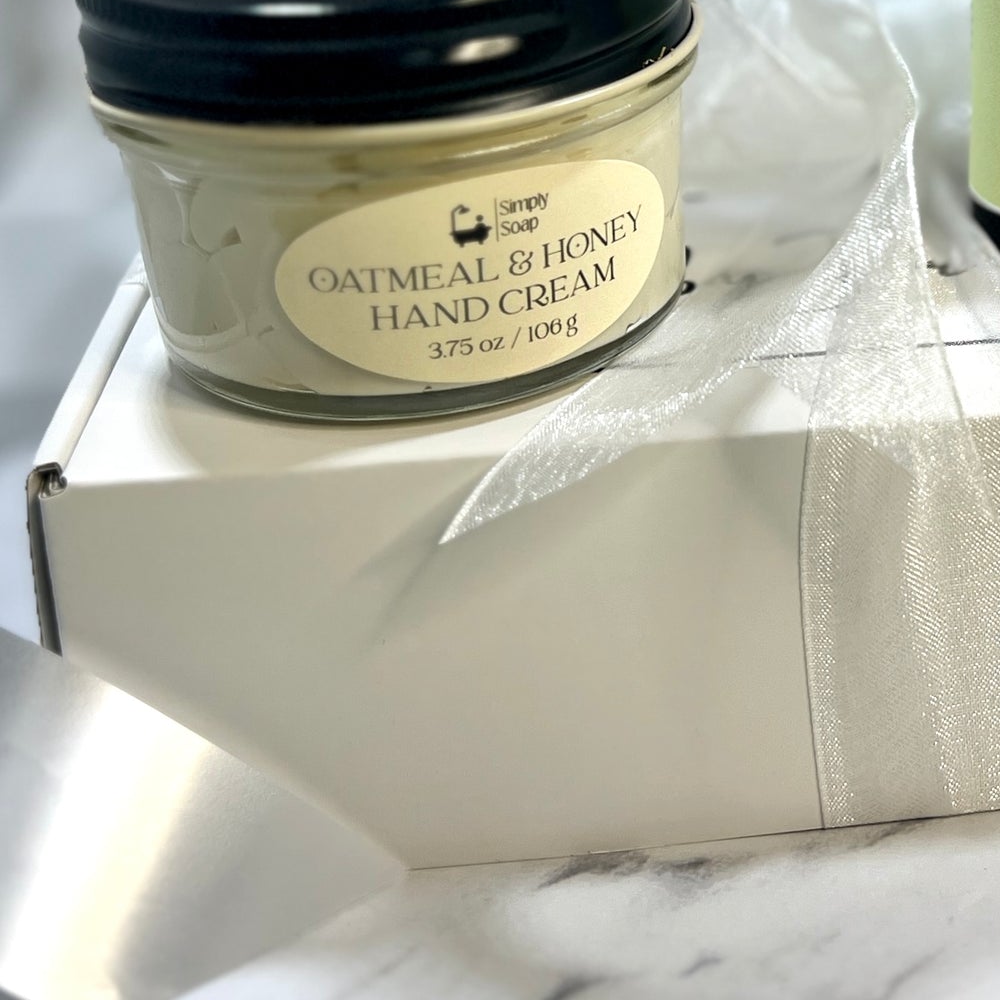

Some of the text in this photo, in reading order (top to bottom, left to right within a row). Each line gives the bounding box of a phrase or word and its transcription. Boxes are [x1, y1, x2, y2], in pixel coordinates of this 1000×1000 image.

[499, 192, 549, 217] Simply
[500, 215, 540, 237] Soap
[308, 203, 642, 294] OATMEAL & HONEY
[370, 256, 617, 331] HAND CREAM
[427, 337, 474, 360] 3.75
[479, 335, 505, 353] oz
[510, 326, 523, 350] /
